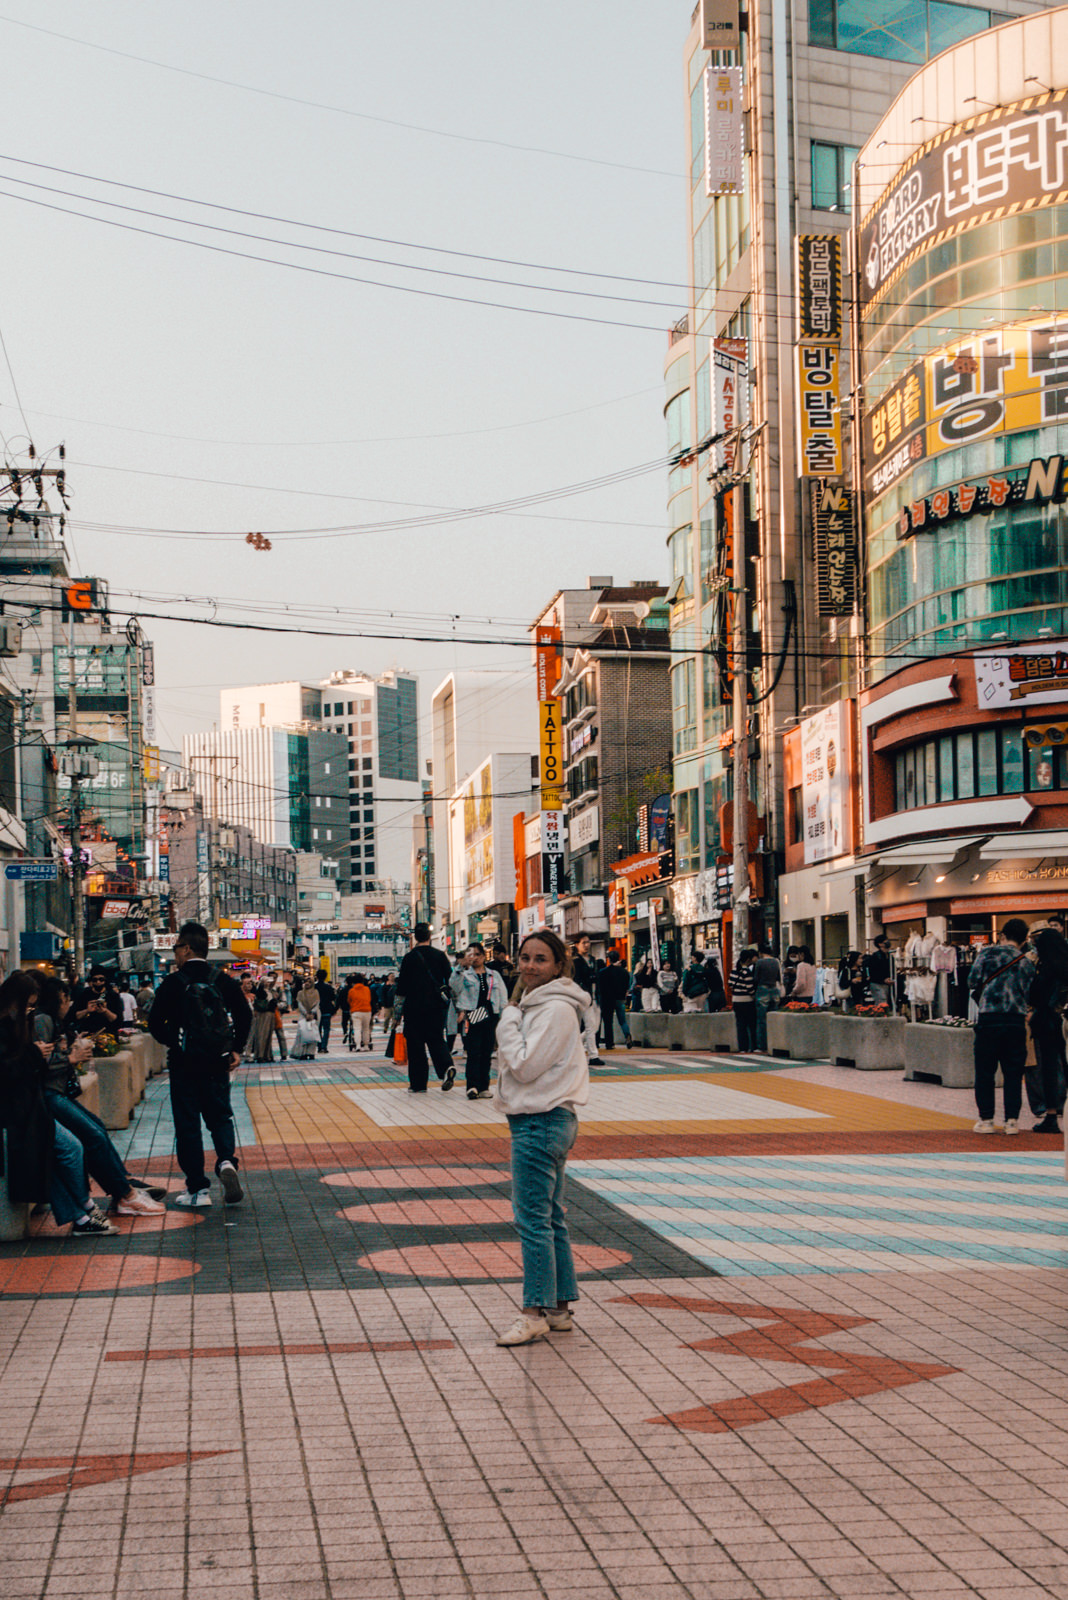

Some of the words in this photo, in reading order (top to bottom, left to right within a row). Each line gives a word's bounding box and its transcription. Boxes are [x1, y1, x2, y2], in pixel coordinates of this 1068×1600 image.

[880, 192, 941, 281] FACTORY
[809, 241, 831, 332] 보드팩토리
[803, 347, 837, 473] 방탈출
[872, 374, 921, 455] 방탈출
[111, 772, 126, 787] 6F
[544, 704, 557, 781] TATTOO
